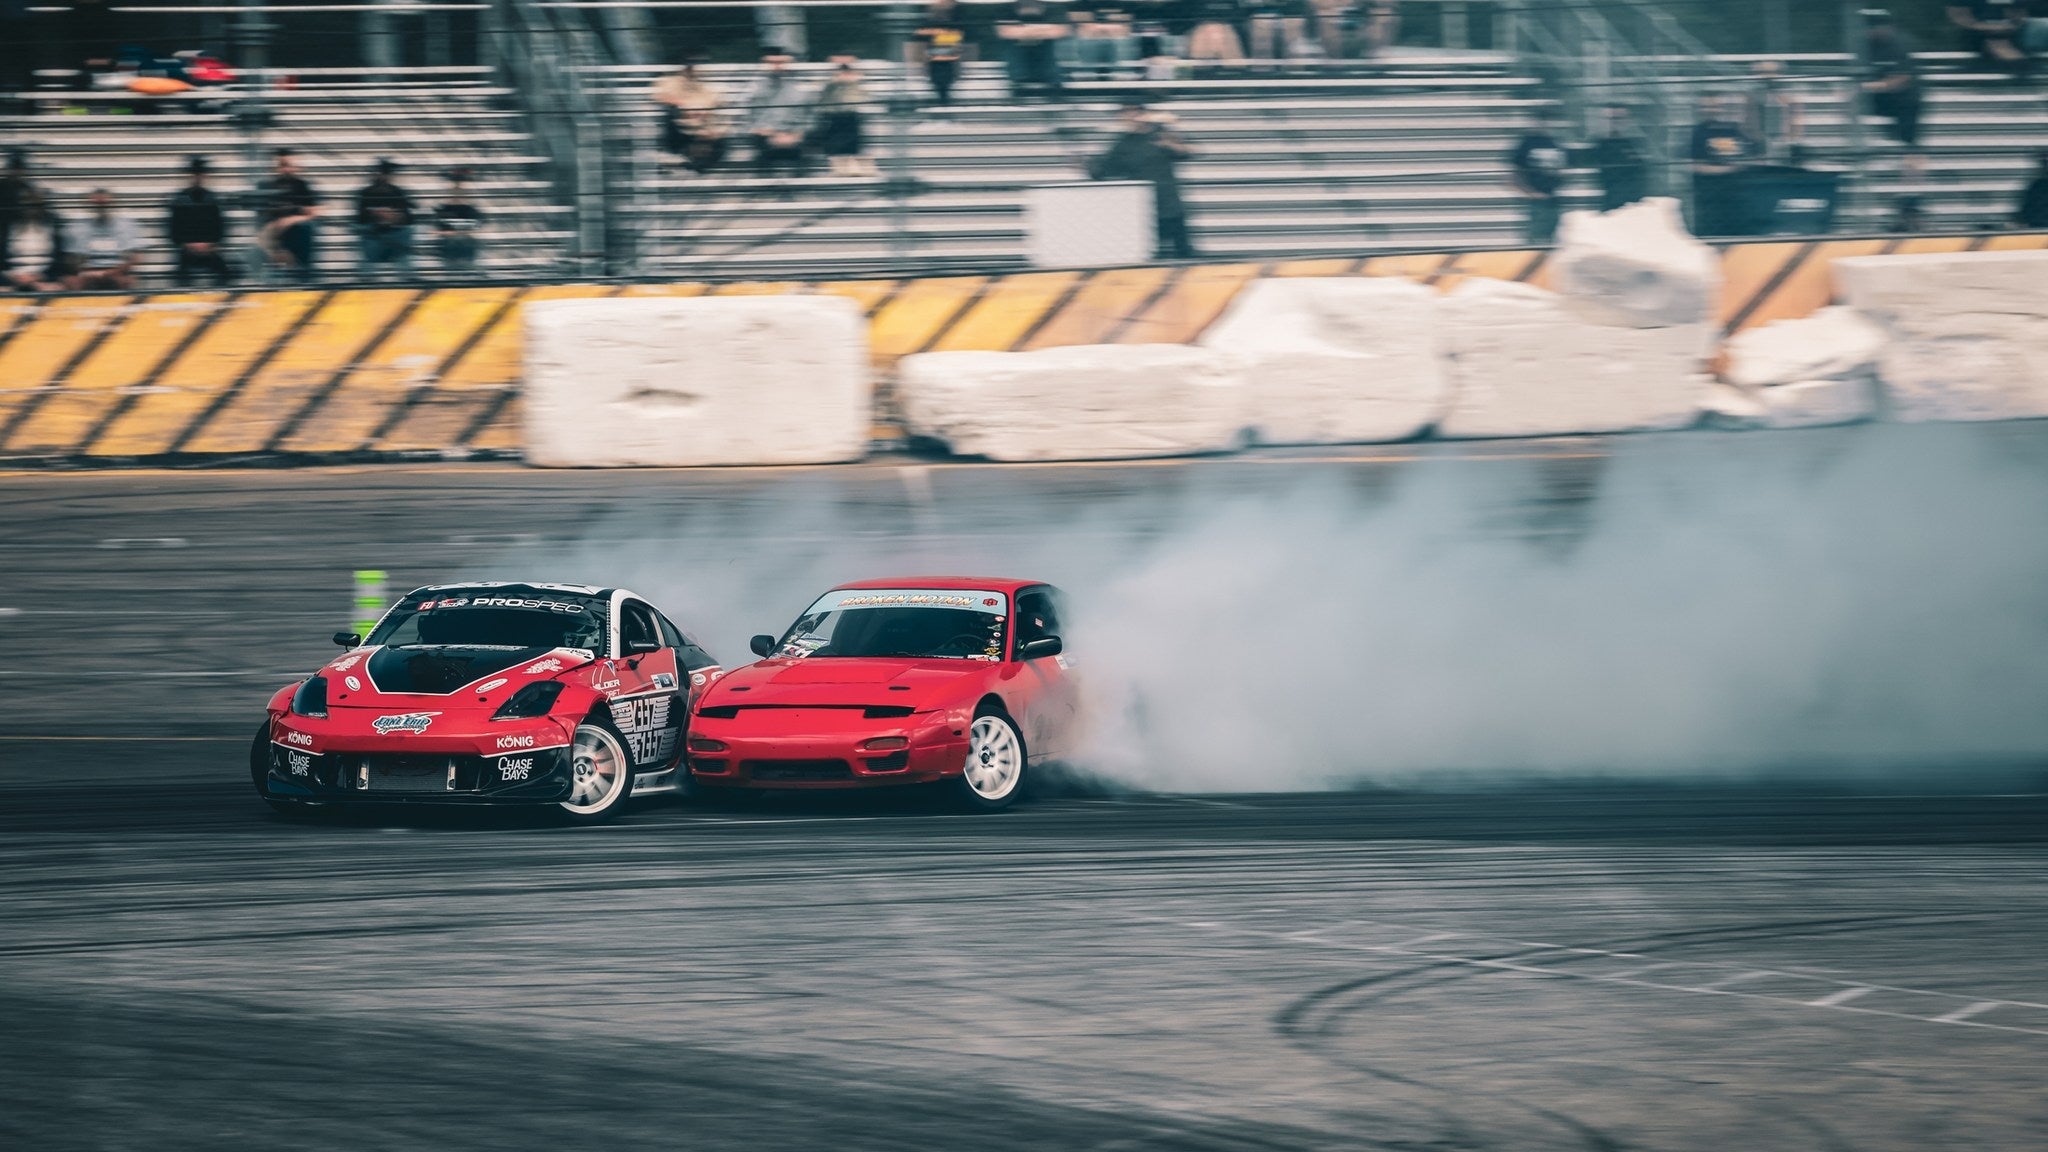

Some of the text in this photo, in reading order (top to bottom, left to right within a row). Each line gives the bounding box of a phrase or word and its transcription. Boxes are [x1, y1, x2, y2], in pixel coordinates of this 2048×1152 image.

[472, 597, 584, 614] PROSPEC
[838, 594, 907, 607] BROKEN
[907, 594, 977, 607] MOTION
[496, 735, 534, 748] KÖNIG
